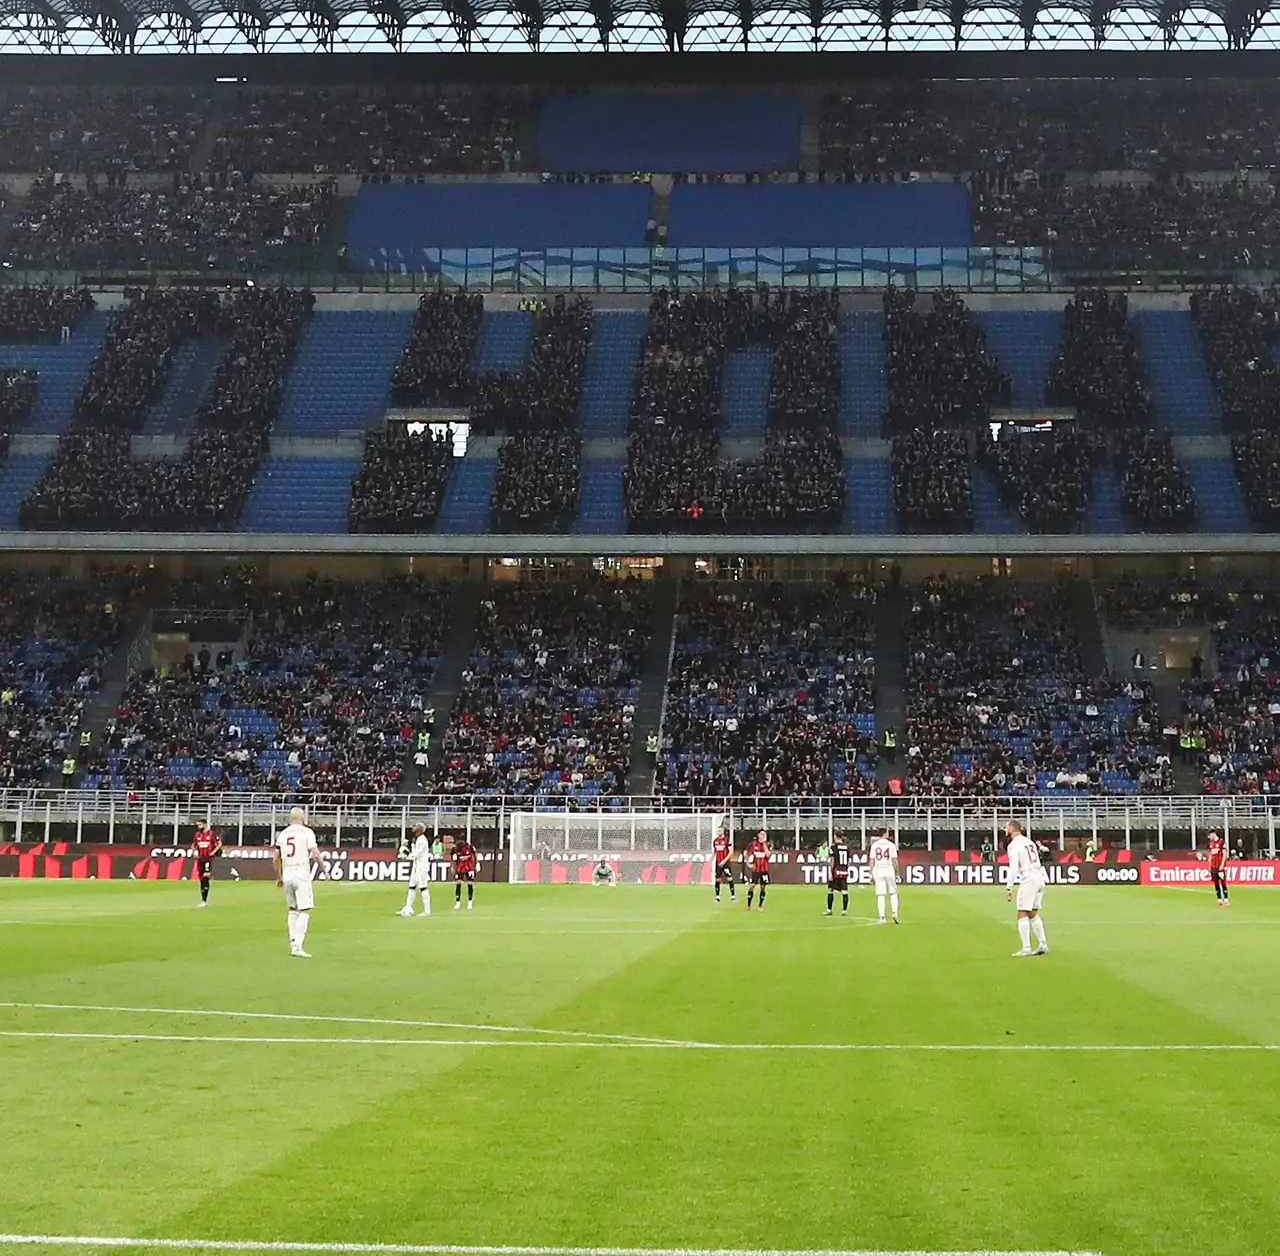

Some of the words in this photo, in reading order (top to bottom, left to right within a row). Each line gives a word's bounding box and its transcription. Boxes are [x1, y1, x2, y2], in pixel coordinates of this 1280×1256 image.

[286, 837, 296, 857] 5
[875, 847, 890, 861] 84
[1024, 845, 1038, 864] 13
[838, 850, 848, 865] 11
[349, 861, 412, 881] HOME
[906, 865, 924, 883] IS
[929, 865, 950, 883] IN
[954, 865, 994, 883] THE
[1096, 867, 1138, 882] 00:00
[1239, 866, 1275, 881] BETTER
